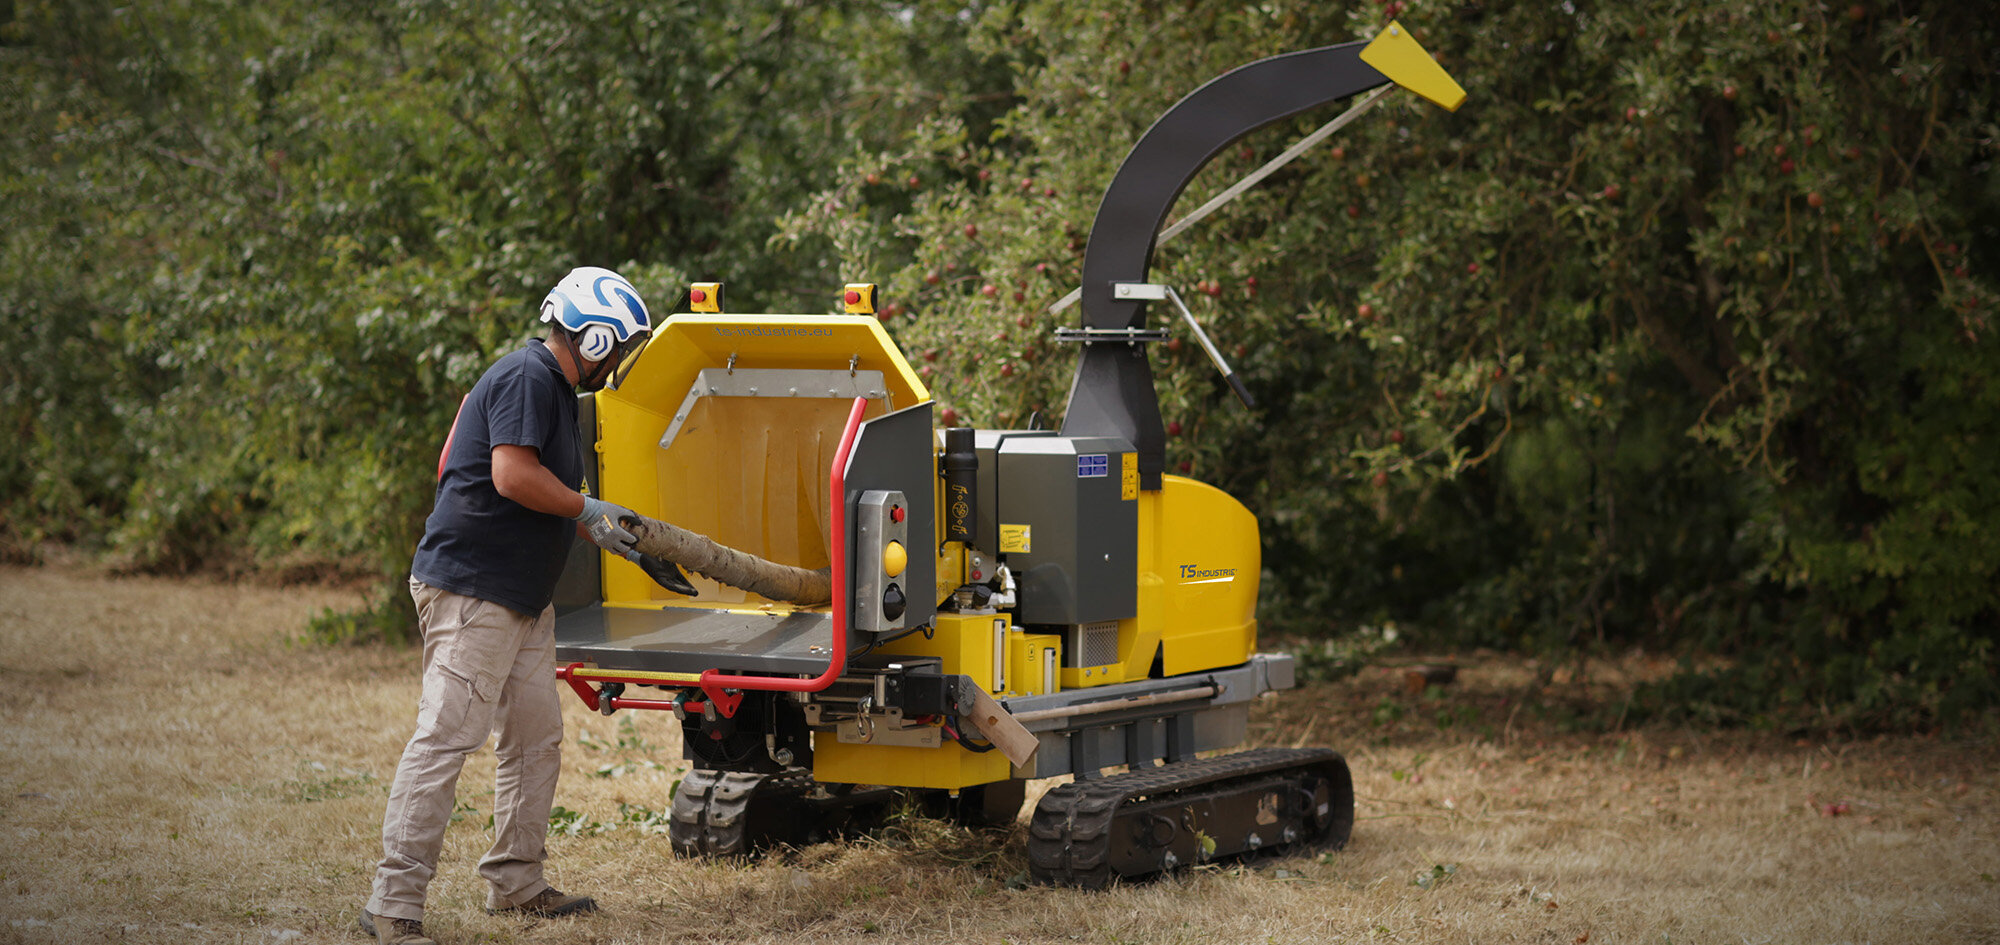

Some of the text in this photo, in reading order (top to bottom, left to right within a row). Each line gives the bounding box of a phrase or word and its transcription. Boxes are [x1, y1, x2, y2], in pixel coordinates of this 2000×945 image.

[715, 325, 833, 337] ts-industrie.eu
[1179, 564, 1236, 579] TS INDUSTRIE
